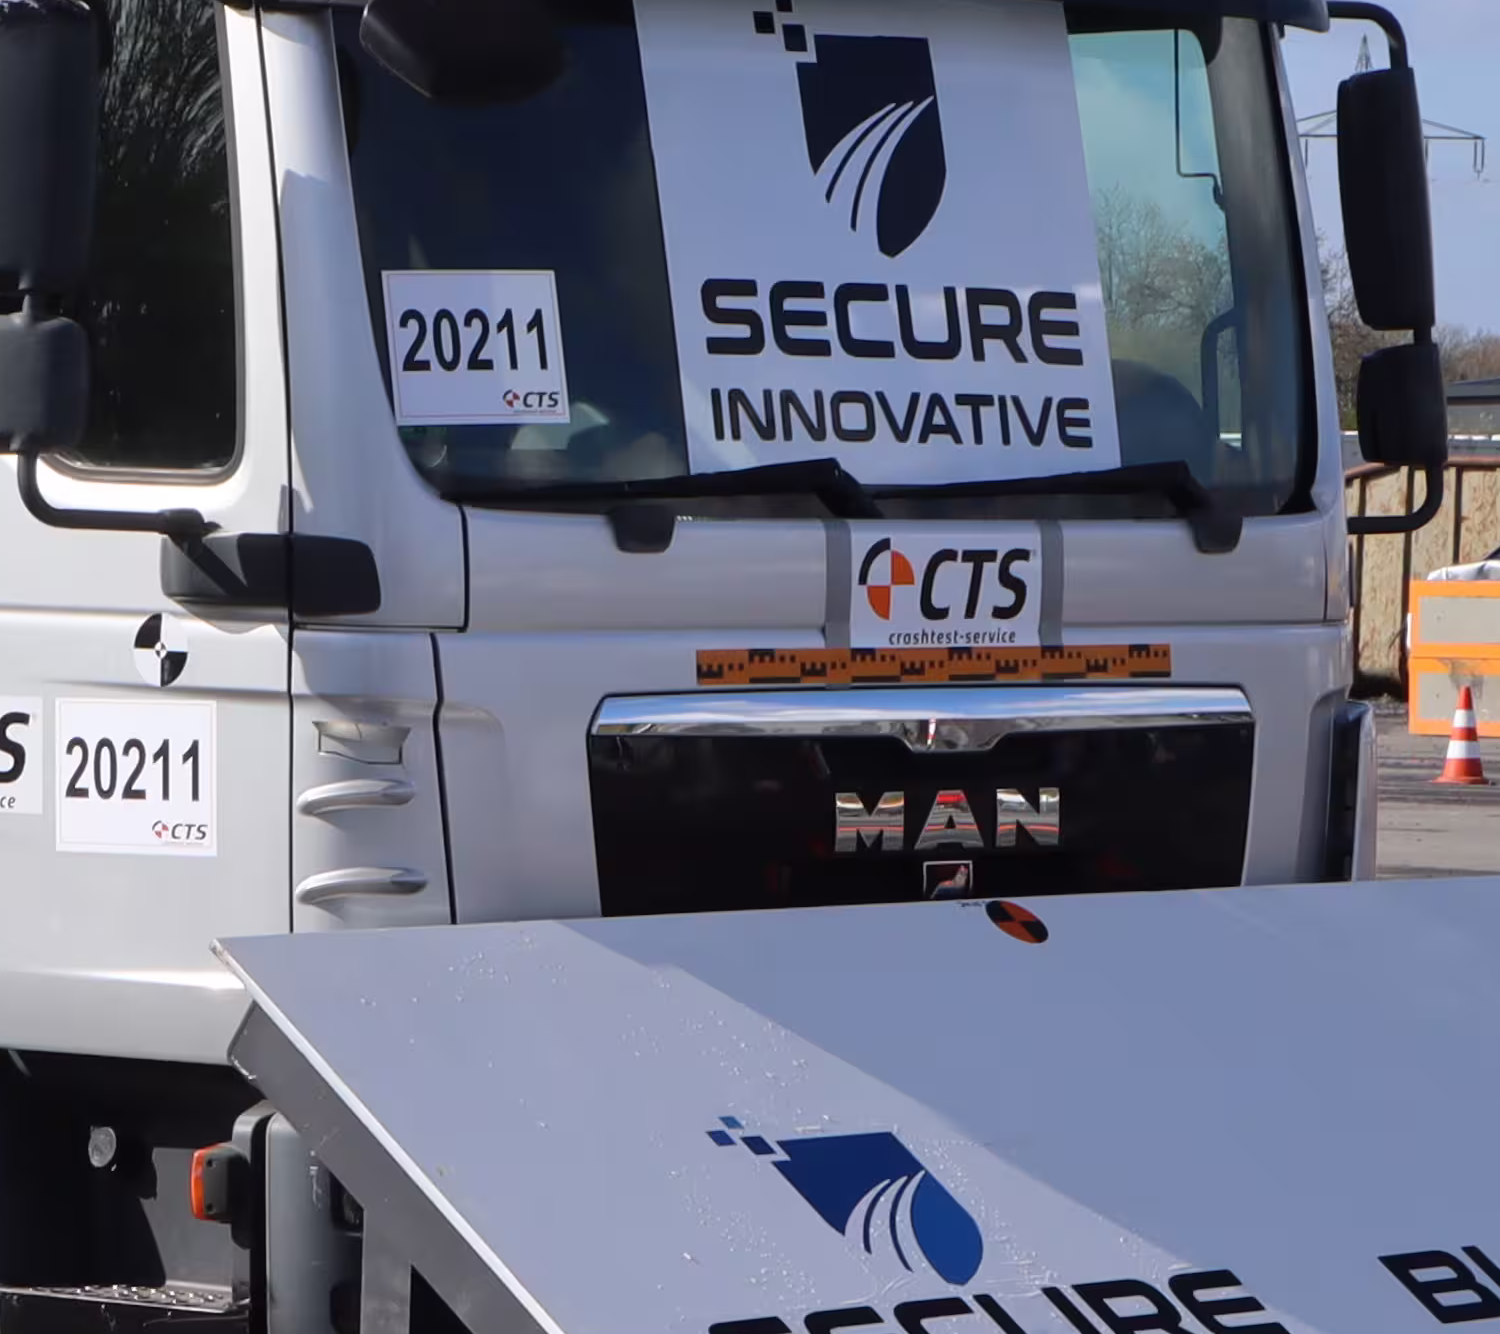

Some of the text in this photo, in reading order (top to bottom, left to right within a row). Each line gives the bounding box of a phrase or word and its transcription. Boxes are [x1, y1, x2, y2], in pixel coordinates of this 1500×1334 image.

[399, 308, 548, 372] 20211
[700, 278, 1084, 366] SECURE
[523, 391, 560, 408] CTS
[710, 388, 1094, 449] INNOVATIVE
[919, 547, 1031, 621] CTS
[889, 627, 1016, 645] crashtest-service
[65, 736, 200, 802] 20211
[171, 823, 208, 840] CTS
[834, 787, 1060, 852] MAN
